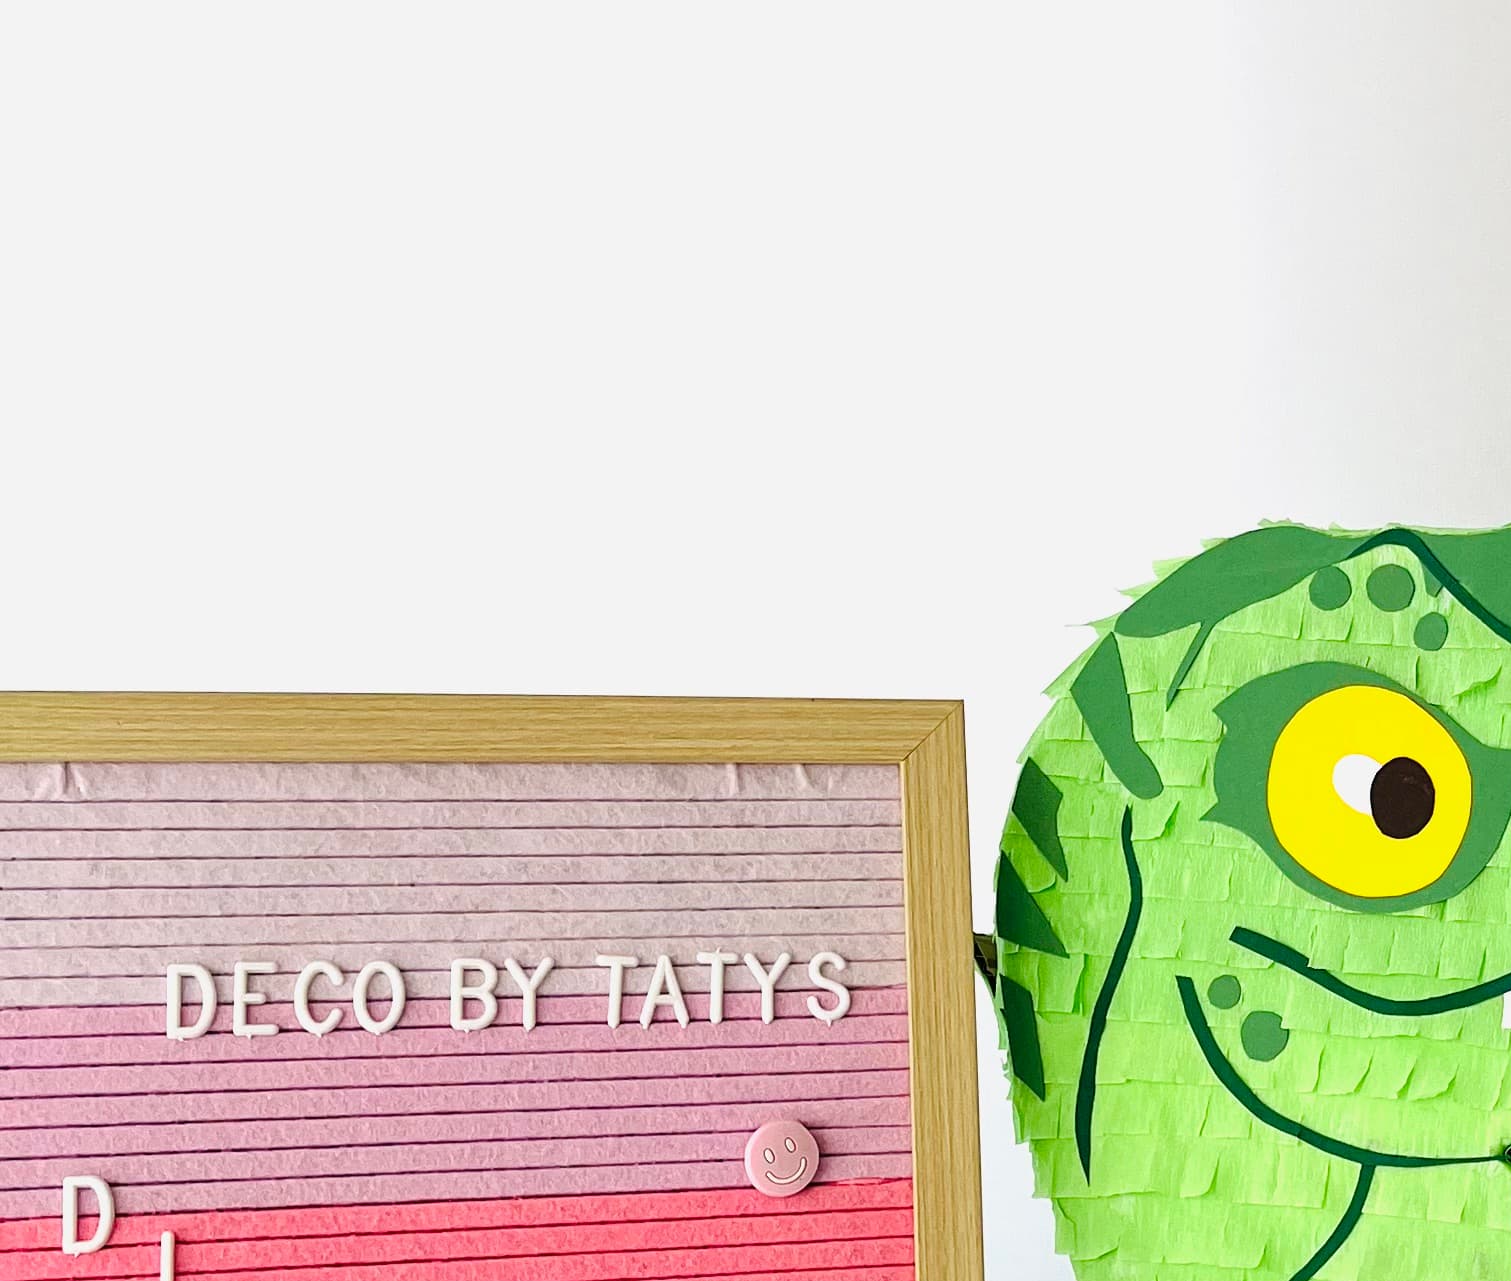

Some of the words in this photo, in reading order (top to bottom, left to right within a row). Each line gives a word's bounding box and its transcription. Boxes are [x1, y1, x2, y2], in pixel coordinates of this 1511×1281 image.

[166, 961, 408, 1041] DECO
[450, 957, 554, 1031] BY
[596, 947, 852, 1027] TATYS
